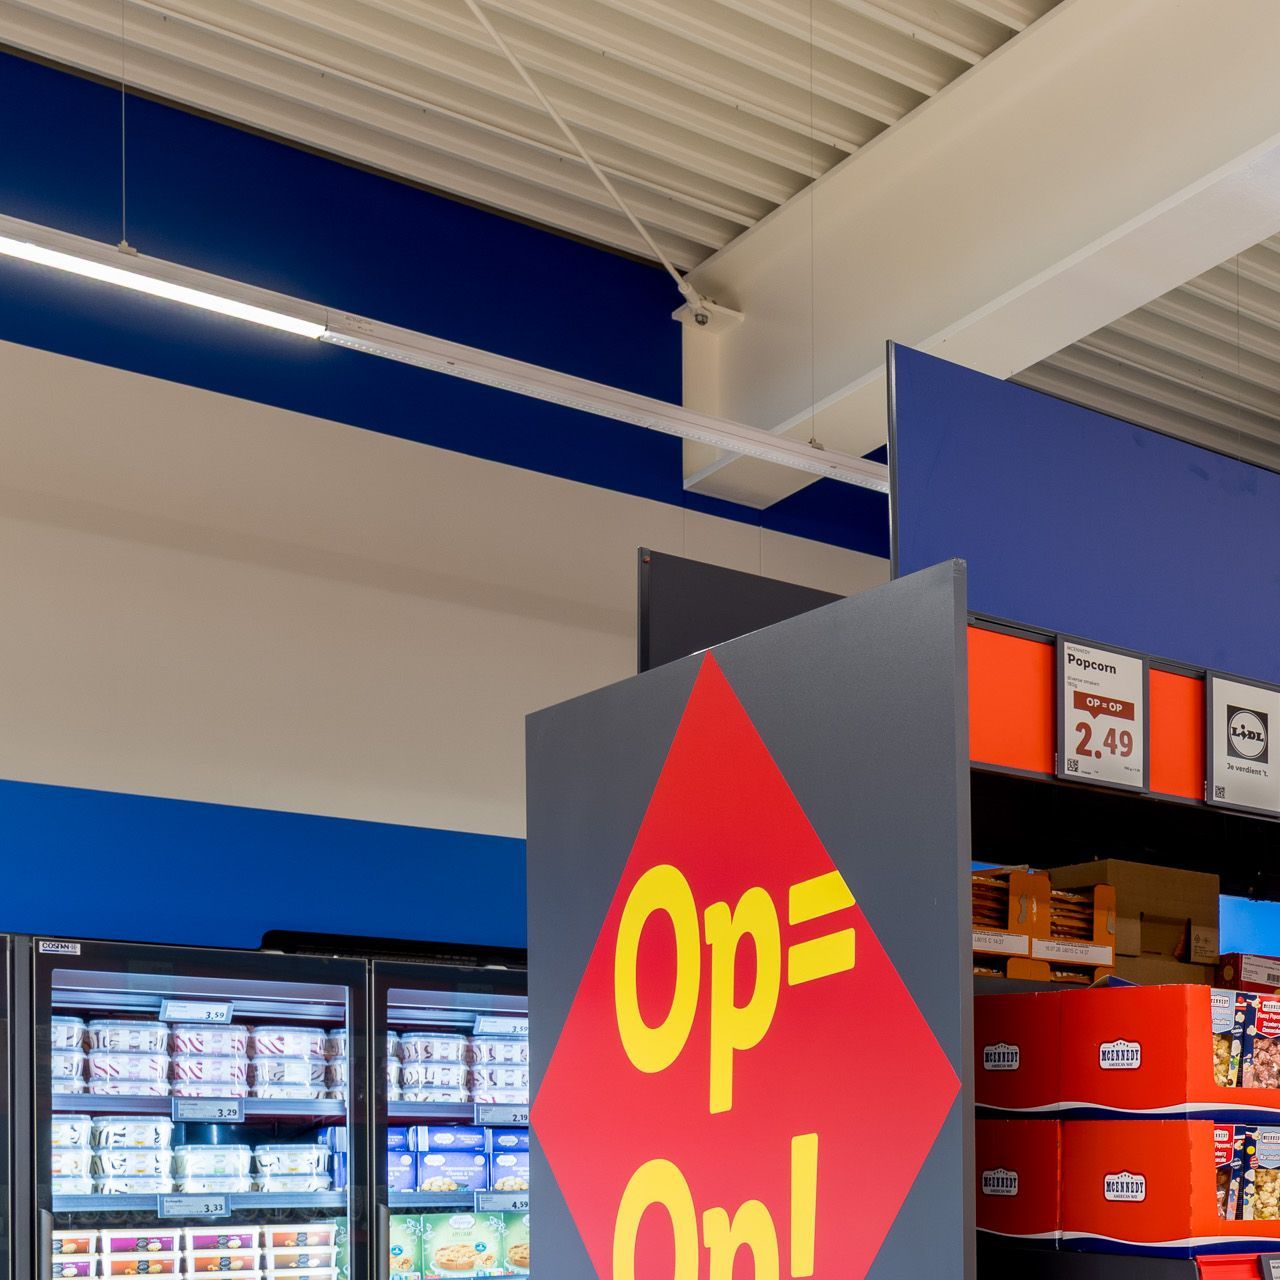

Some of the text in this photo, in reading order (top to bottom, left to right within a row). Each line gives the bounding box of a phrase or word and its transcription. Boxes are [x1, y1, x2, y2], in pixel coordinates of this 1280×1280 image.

[1067, 653, 1117, 675] Popcorn
[1086, 697, 1100, 708] OP
[1109, 702, 1122, 712] OP
[1075, 721, 1133, 759] 2.49
[1227, 762, 1234, 771] Je
[1235, 764, 1261, 775] verdient
[615, 864, 856, 1114] Op=
[205, 1010, 225, 1020] 3.59
[512, 1025, 528, 1033] 3.59
[985, 1051, 1018, 1063] MCENNEDY
[1101, 1049, 1139, 1062] MCENNEDY
[217, 1108, 237, 1118] 3.29
[512, 1113, 528, 1123] 2.19
[984, 1177, 1017, 1189] MCENNEDY
[1106, 1181, 1144, 1194] MCENNEDY
[204, 1203, 224, 1213] 3.33
[511, 1200, 528, 1210] 4.59
